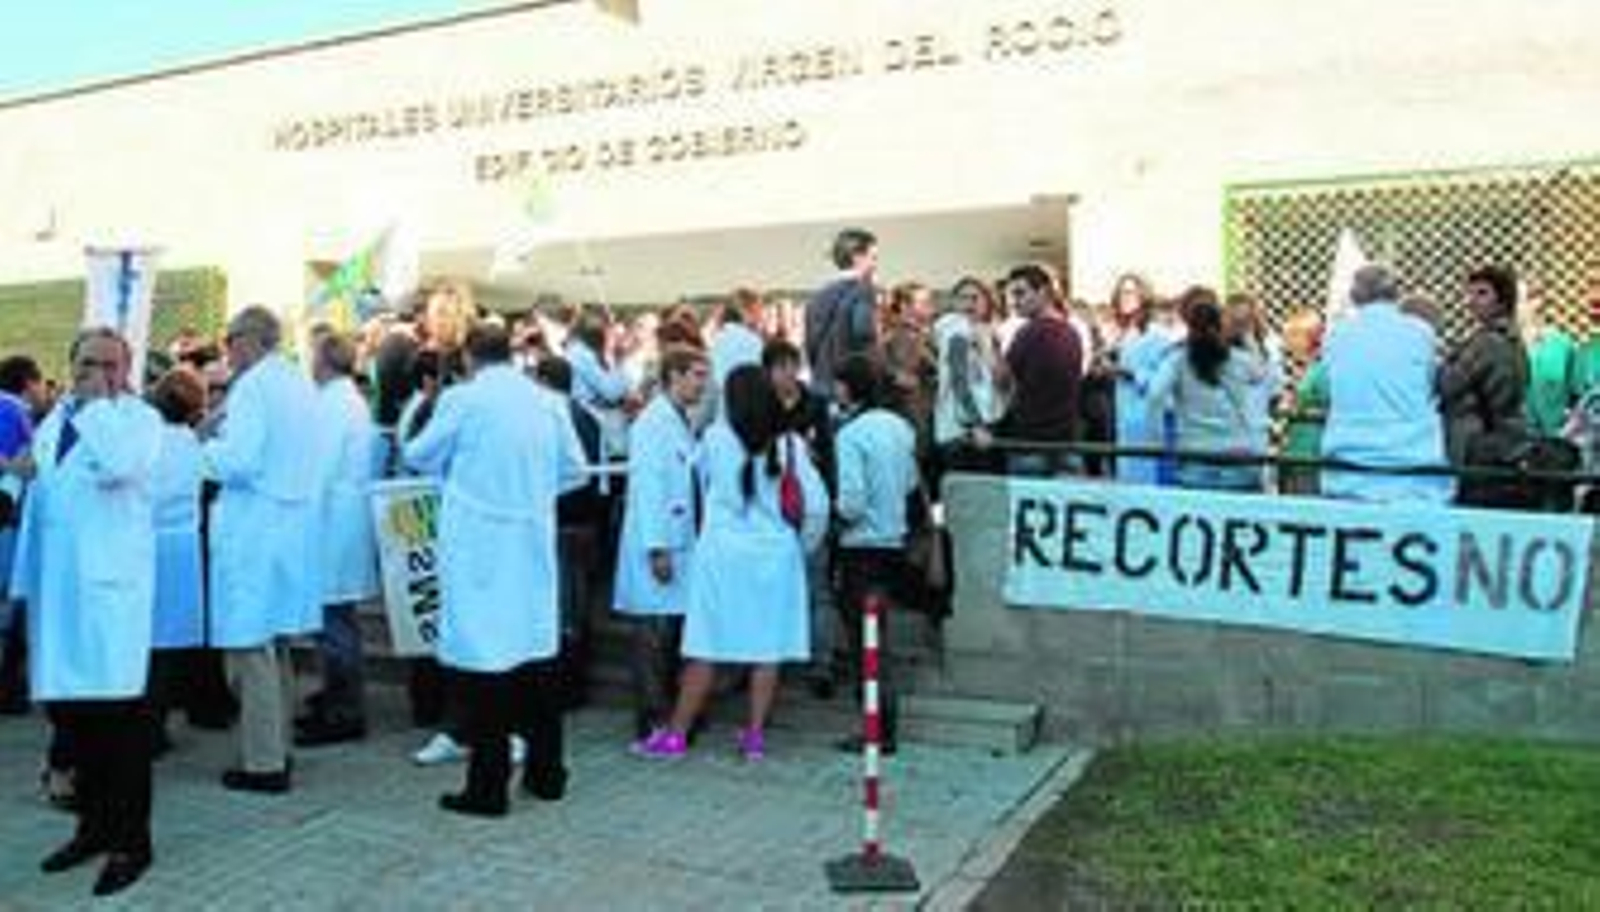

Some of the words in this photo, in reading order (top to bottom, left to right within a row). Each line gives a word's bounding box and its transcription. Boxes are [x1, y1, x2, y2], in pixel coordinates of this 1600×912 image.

[885, 35, 960, 72] DEL
[596, 139, 636, 170] DE
[1013, 498, 1438, 605] RECORTES
[1455, 529, 1575, 611] NO
